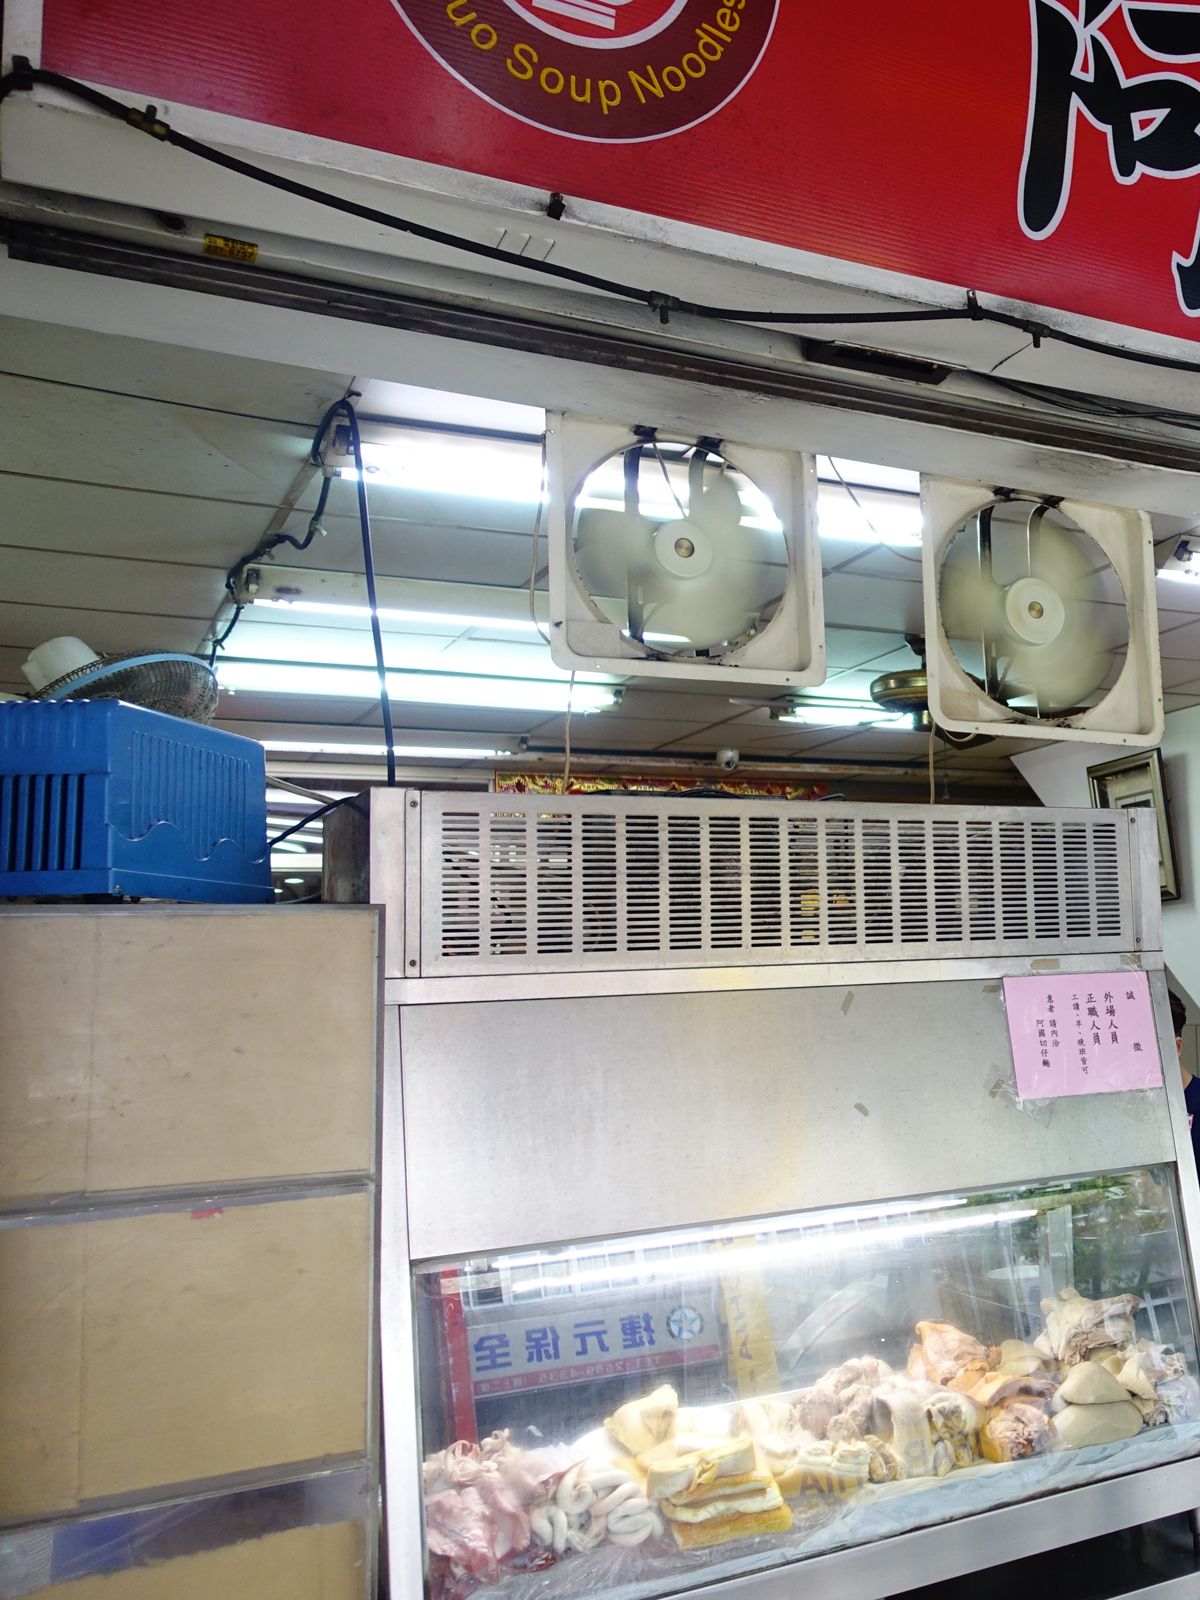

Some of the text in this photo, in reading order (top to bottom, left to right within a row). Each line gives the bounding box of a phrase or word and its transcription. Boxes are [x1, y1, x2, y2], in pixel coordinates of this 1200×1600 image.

[506, 43, 621, 115] Soup
[1086, 993, 1101, 1046] 正職人員
[1104, 991, 1119, 1045] 外場人員
